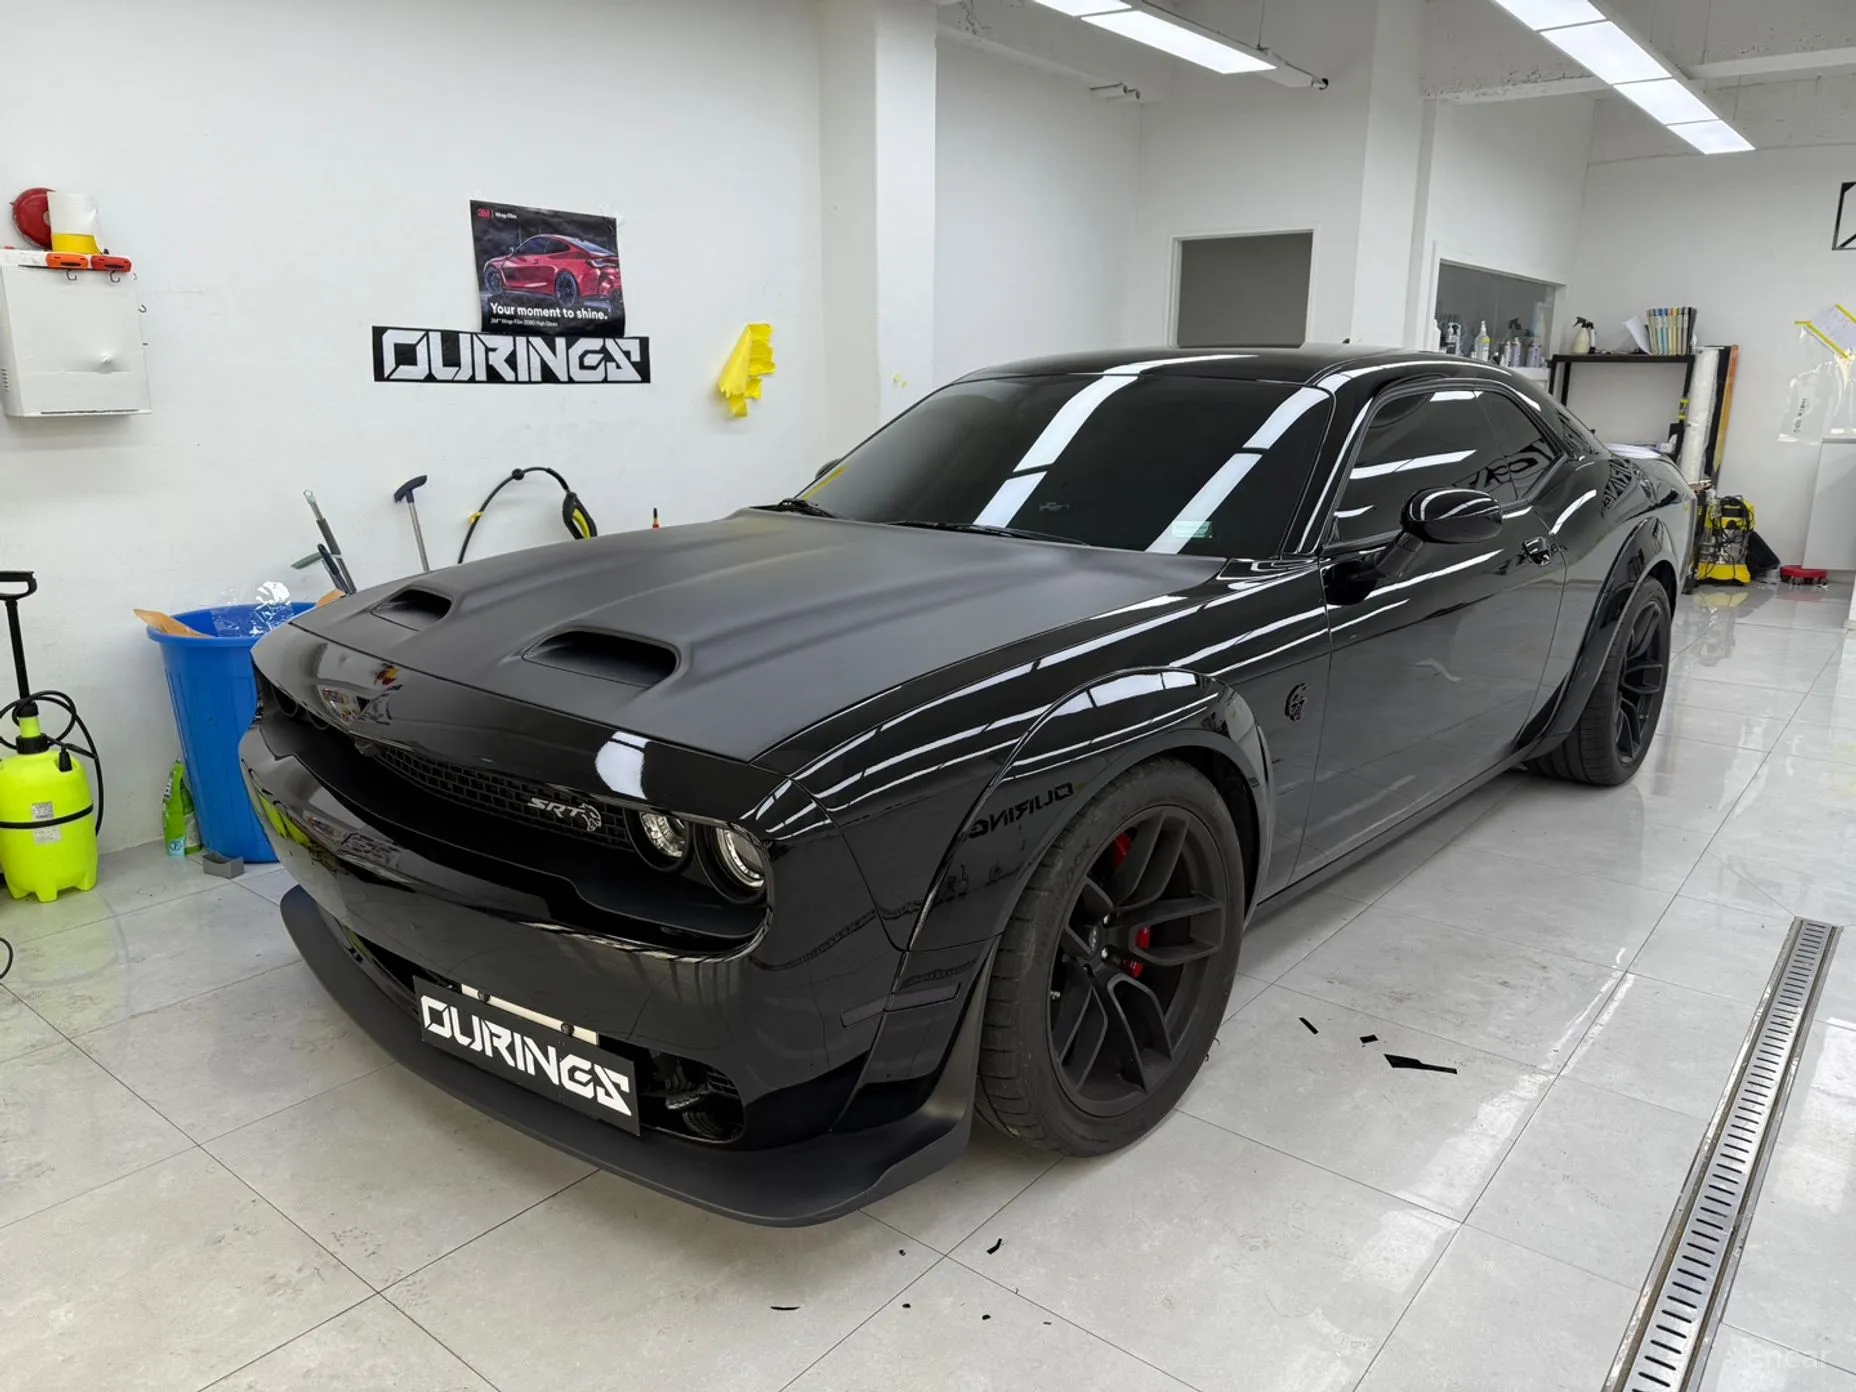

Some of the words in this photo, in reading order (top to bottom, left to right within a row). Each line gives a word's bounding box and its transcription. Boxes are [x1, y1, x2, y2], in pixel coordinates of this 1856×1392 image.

[490, 302, 515, 316] Your
[517, 305, 561, 319] moment
[562, 307, 575, 320] to
[576, 307, 608, 321] shine.
[381, 331, 642, 383] OURINGS
[527, 796, 586, 818] SRT
[420, 994, 632, 1117] OURINGS
